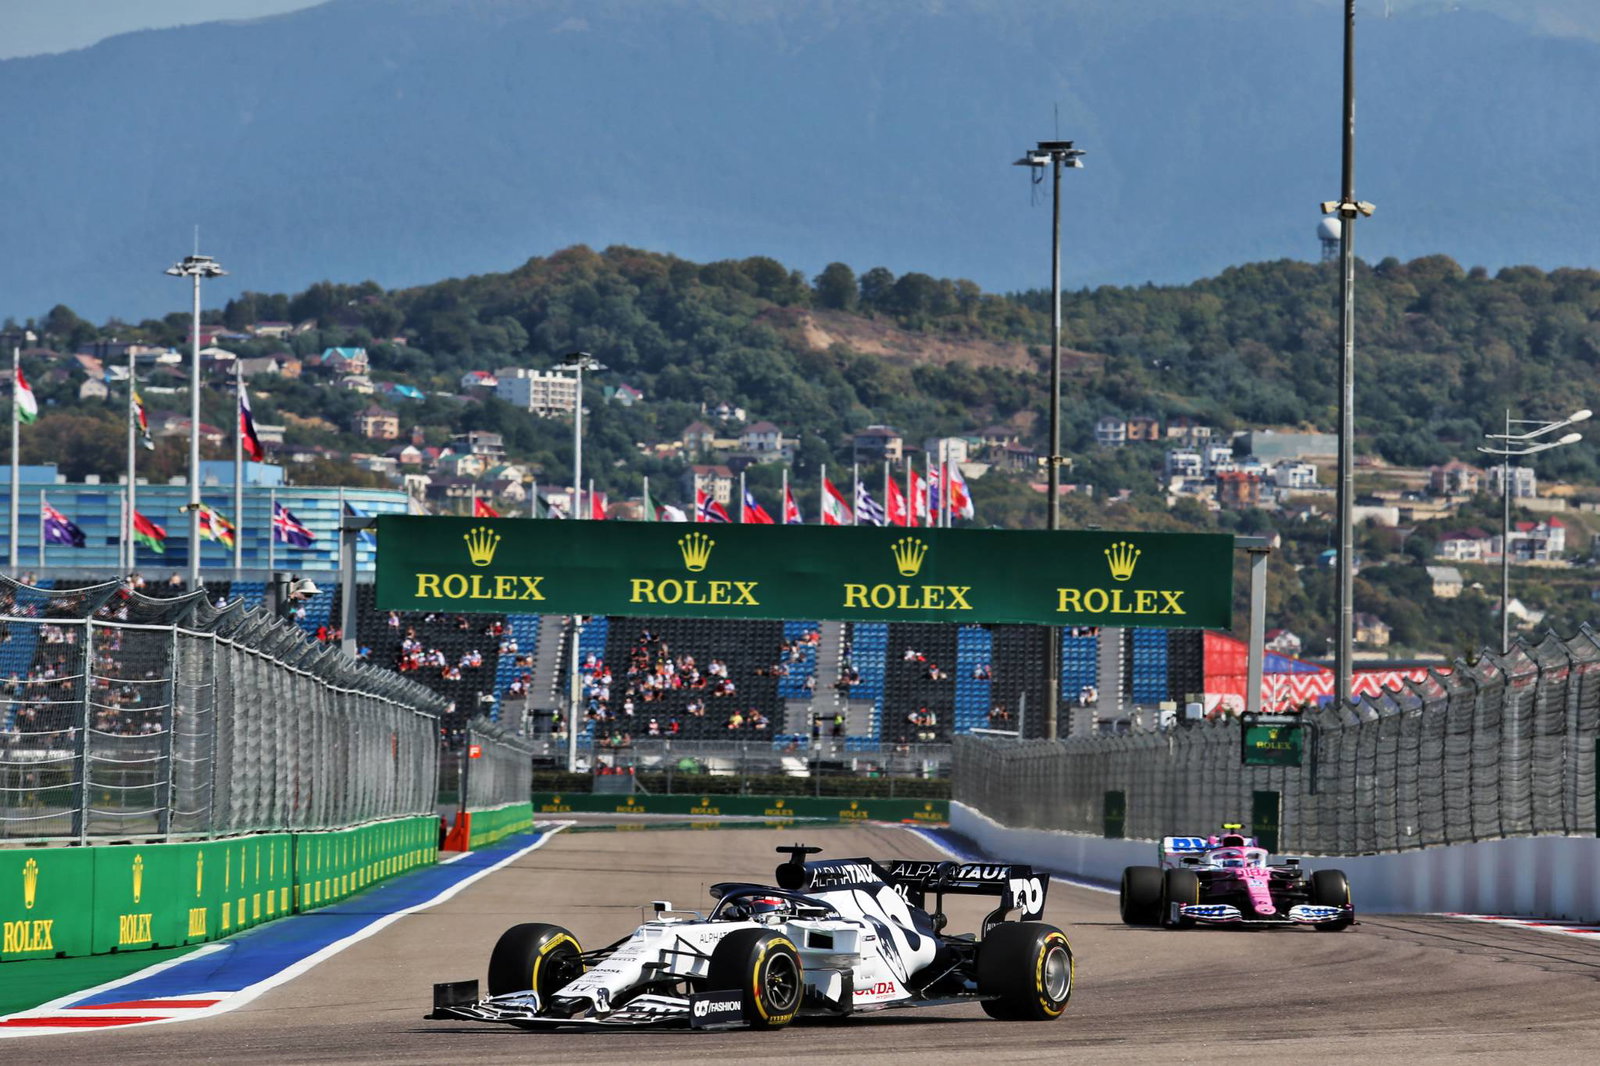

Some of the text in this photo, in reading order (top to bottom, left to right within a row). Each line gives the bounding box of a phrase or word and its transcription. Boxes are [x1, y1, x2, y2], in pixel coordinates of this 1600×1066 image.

[416, 573, 545, 600] ROLEX
[631, 578, 758, 606] ROLEX
[844, 583, 972, 610] ROLEX
[1058, 587, 1185, 615] ROLEX
[2, 919, 54, 953] ROLEX
[118, 913, 153, 945] ROLEX
